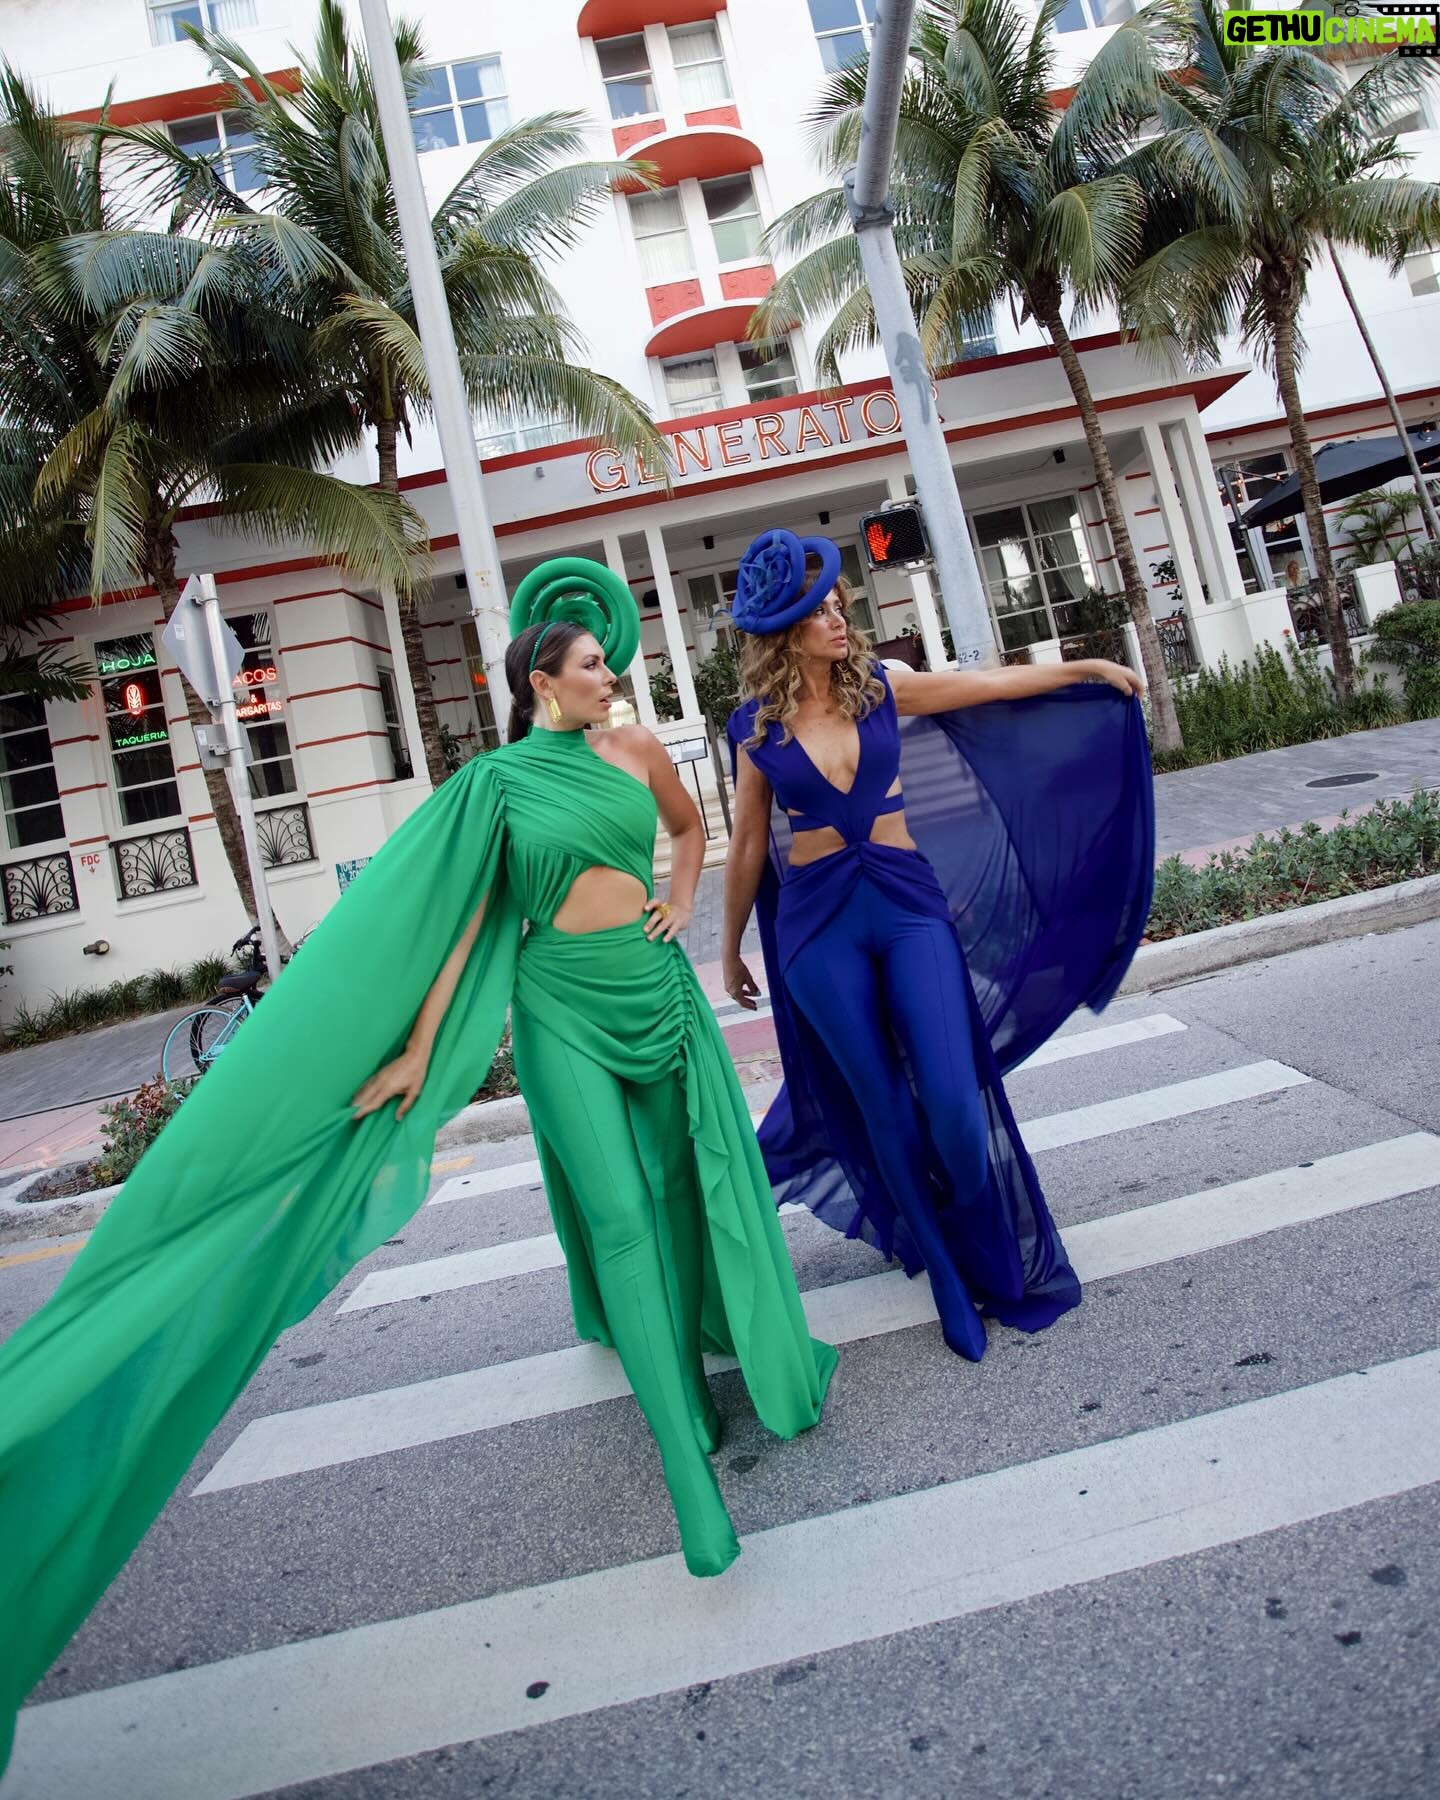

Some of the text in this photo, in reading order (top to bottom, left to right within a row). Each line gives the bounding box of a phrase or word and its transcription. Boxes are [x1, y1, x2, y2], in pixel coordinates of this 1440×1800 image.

[586, 386, 944, 493] GENERATO
[102, 653, 156, 673] HOJA
[231, 667, 277, 687] ACOS
[250, 694, 257, 704] &
[236, 701, 282, 718] ARGARITAS
[115, 731, 167, 747] TAQUERIA
[80, 853, 100, 867] FDC
